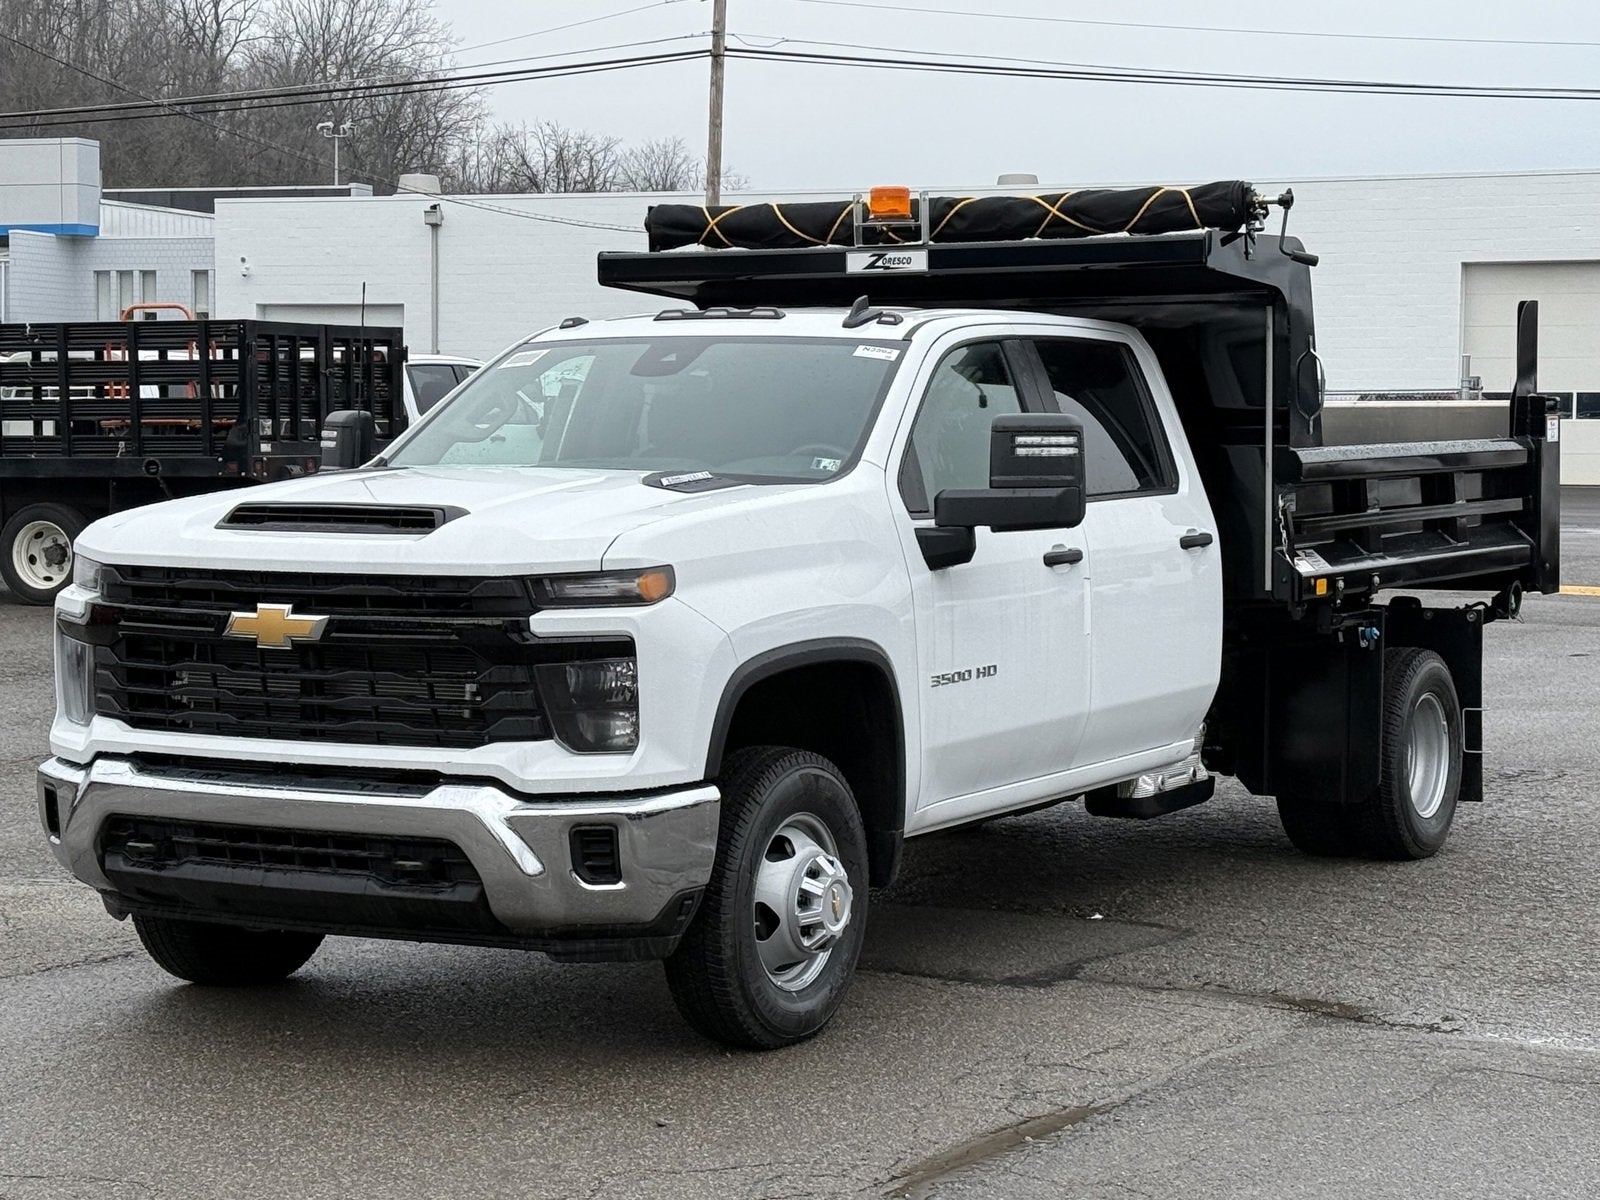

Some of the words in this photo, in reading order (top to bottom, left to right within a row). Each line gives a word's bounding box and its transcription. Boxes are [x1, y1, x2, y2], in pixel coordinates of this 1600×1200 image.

[862, 253, 912, 270] ZORESCO
[931, 669, 972, 688] 3500
[976, 665, 997, 679] HD
